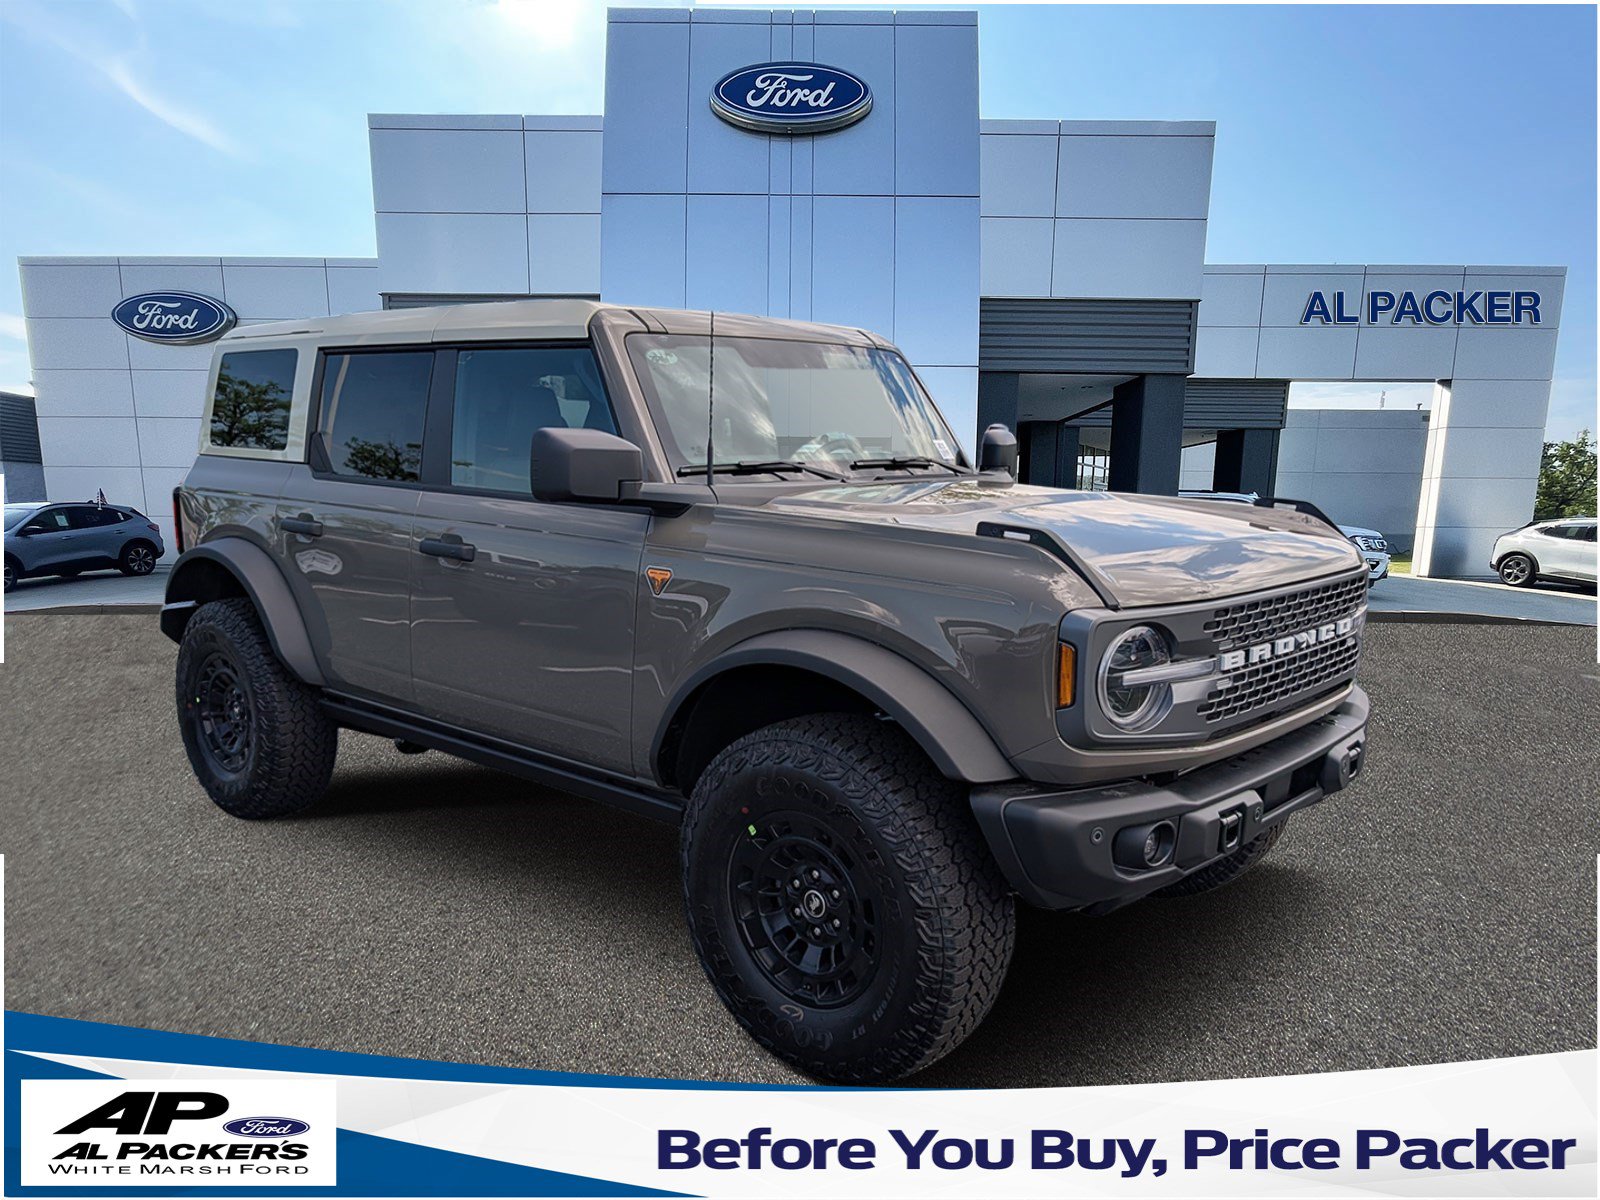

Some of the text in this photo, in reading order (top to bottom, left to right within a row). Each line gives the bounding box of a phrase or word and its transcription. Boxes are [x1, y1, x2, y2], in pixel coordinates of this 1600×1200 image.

[746, 73, 836, 107] Ford
[133, 301, 199, 329] Ford
[1302, 290, 1541, 325] AL PACKER
[1220, 617, 1352, 671] BRONCO
